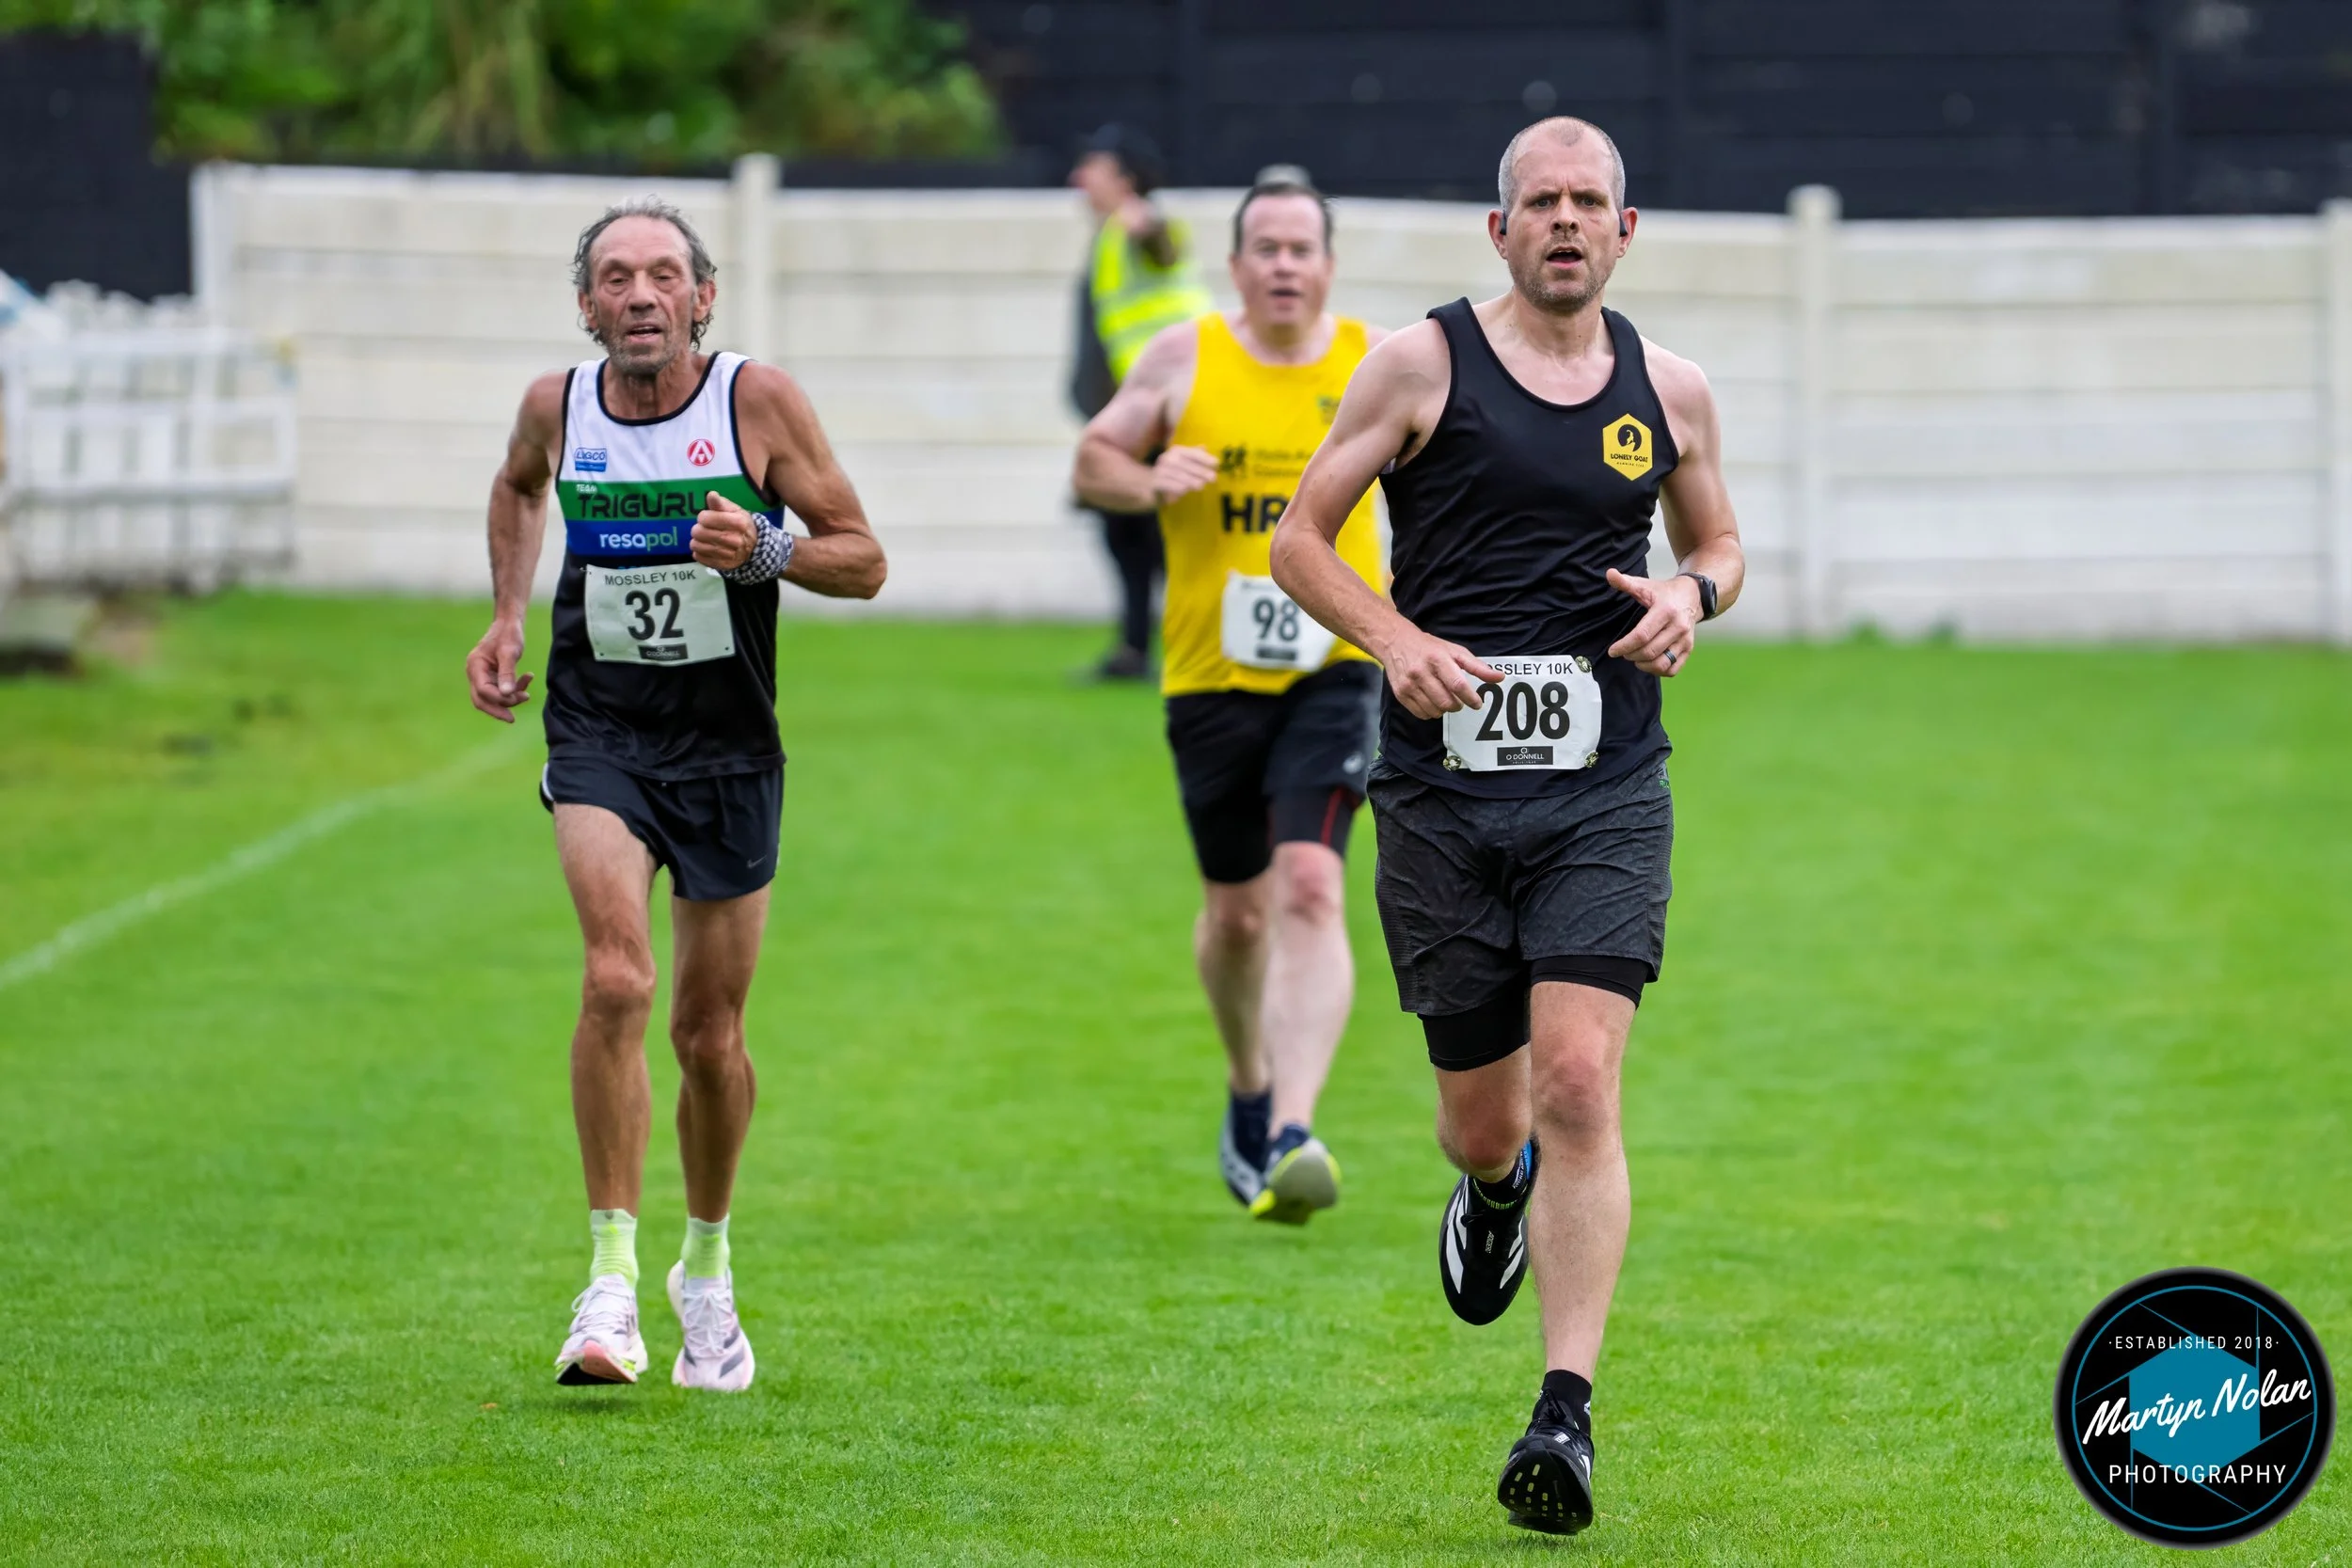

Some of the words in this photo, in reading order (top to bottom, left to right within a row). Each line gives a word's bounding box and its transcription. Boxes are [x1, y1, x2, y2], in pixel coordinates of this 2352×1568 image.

[578, 491, 709, 518] TRIGURU
[599, 526, 678, 552] resapol
[605, 572, 667, 586] MOSSLEY
[672, 569, 696, 581] 10K
[625, 587, 684, 641] 32
[1253, 596, 1300, 641] 98
[1487, 663, 1542, 675] SSLEY
[1547, 662, 1574, 675] 10K
[1475, 681, 1570, 741] 208
